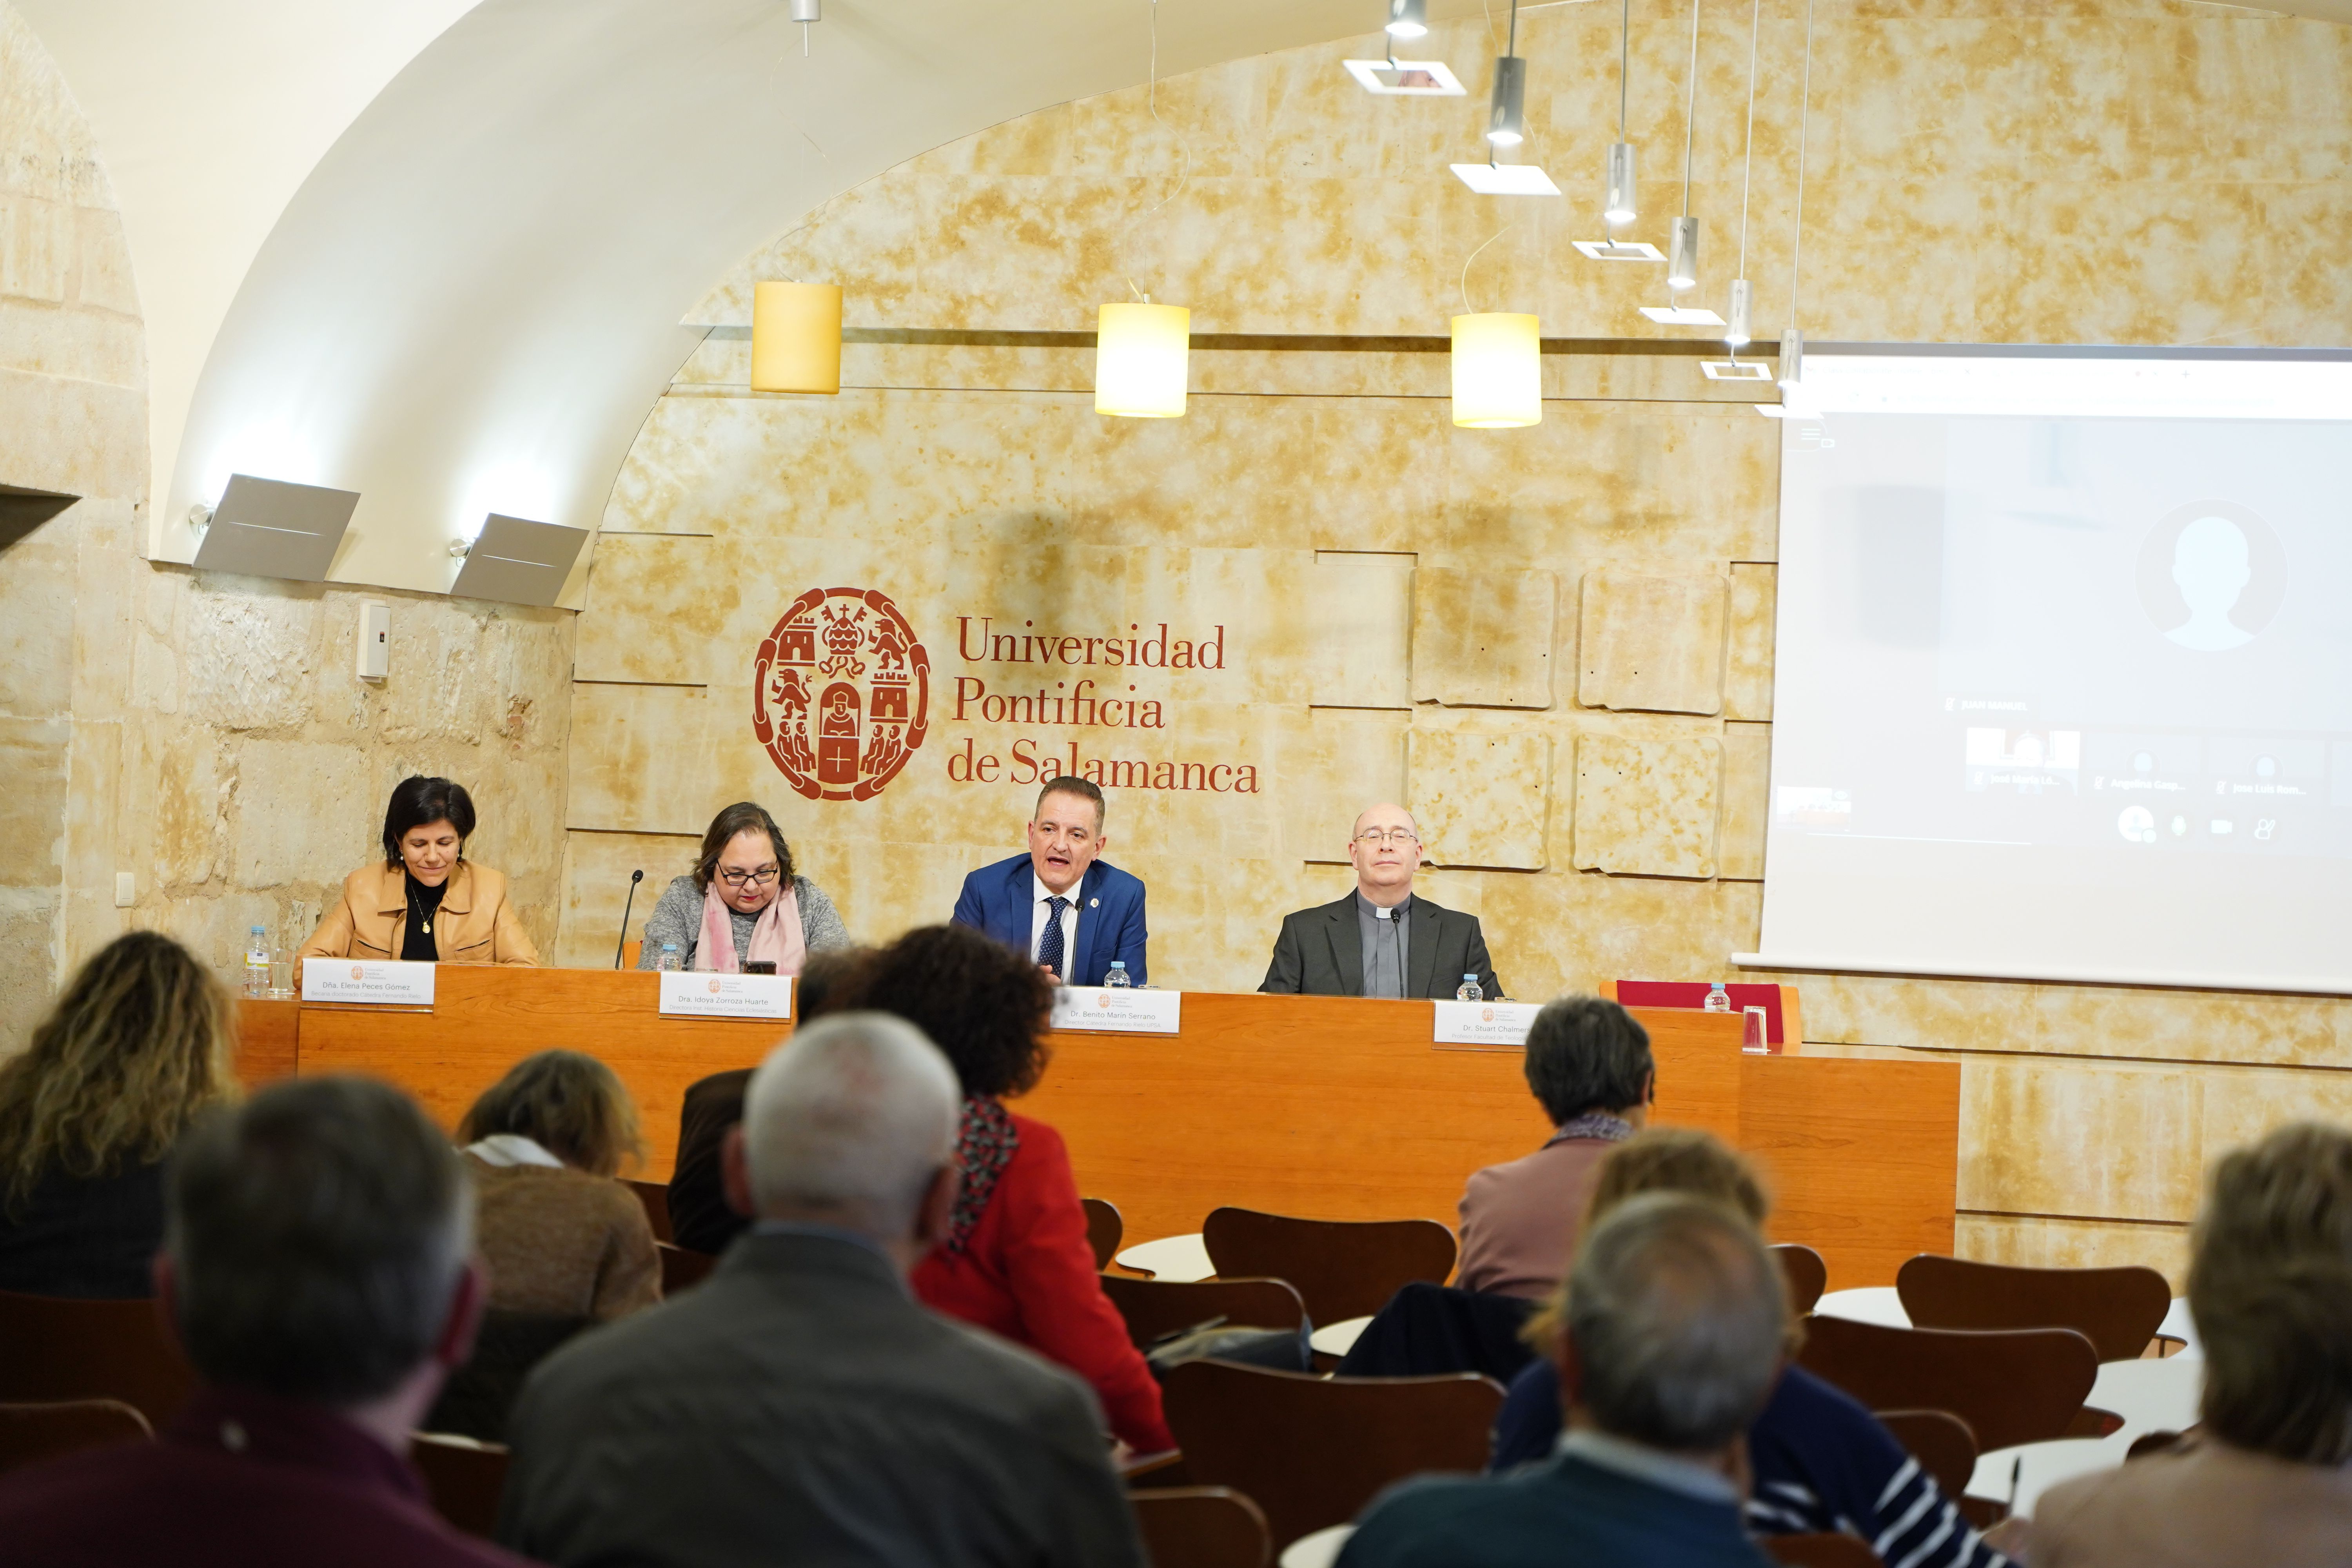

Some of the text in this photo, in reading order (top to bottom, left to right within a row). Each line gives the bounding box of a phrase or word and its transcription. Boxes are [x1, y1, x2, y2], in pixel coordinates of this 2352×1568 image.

[956, 616, 1225, 670] Universidad
[951, 676, 1165, 729] Pontificia
[1961, 700, 2027, 711] JUAN MANUEL
[947, 738, 1261, 793] de Salamanca
[1991, 775, 2010, 784] José
[2111, 779, 2152, 790] Angelina
[2233, 784, 2253, 793] Jose
[2256, 784, 2274, 793] Luis
